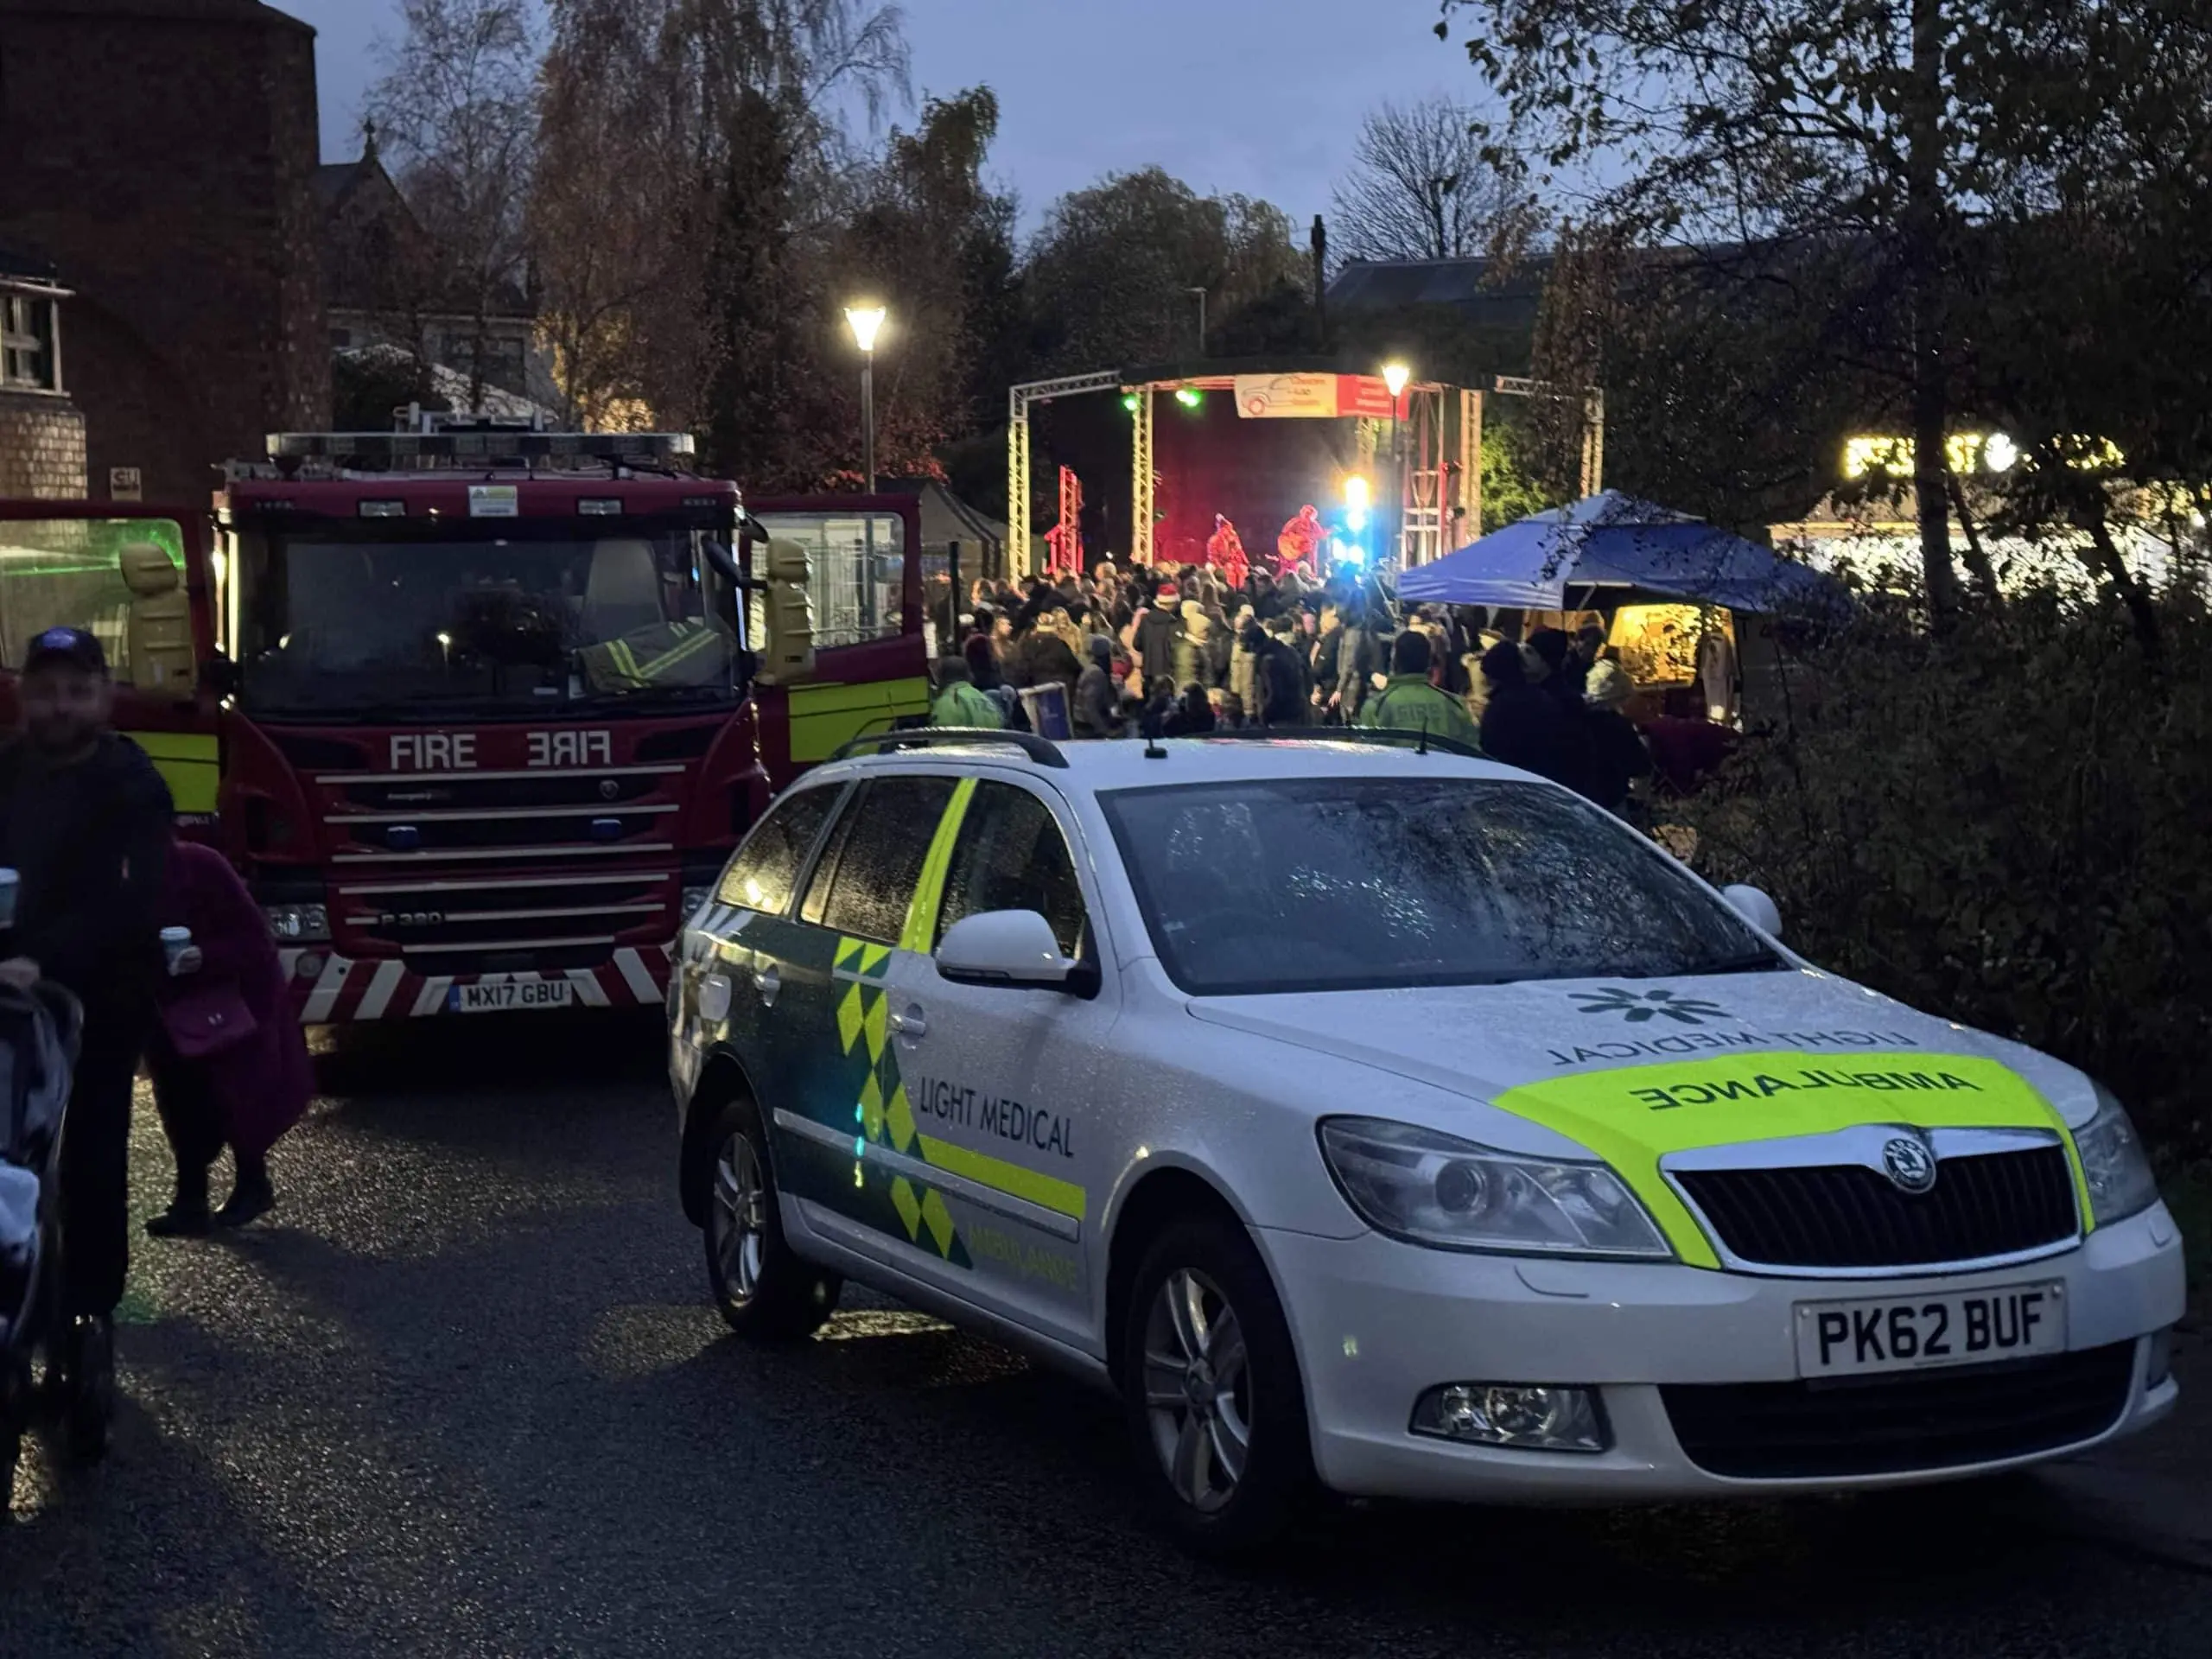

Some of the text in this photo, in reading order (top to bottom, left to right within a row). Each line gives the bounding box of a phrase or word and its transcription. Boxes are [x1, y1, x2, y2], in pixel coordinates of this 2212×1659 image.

[390, 734, 477, 770] FIRE
[467, 982, 564, 1007] MX17 GBU
[920, 1077, 1075, 1159] LIGHT MEDICAL
[1817, 1293, 2044, 1365] PK62 BUF
